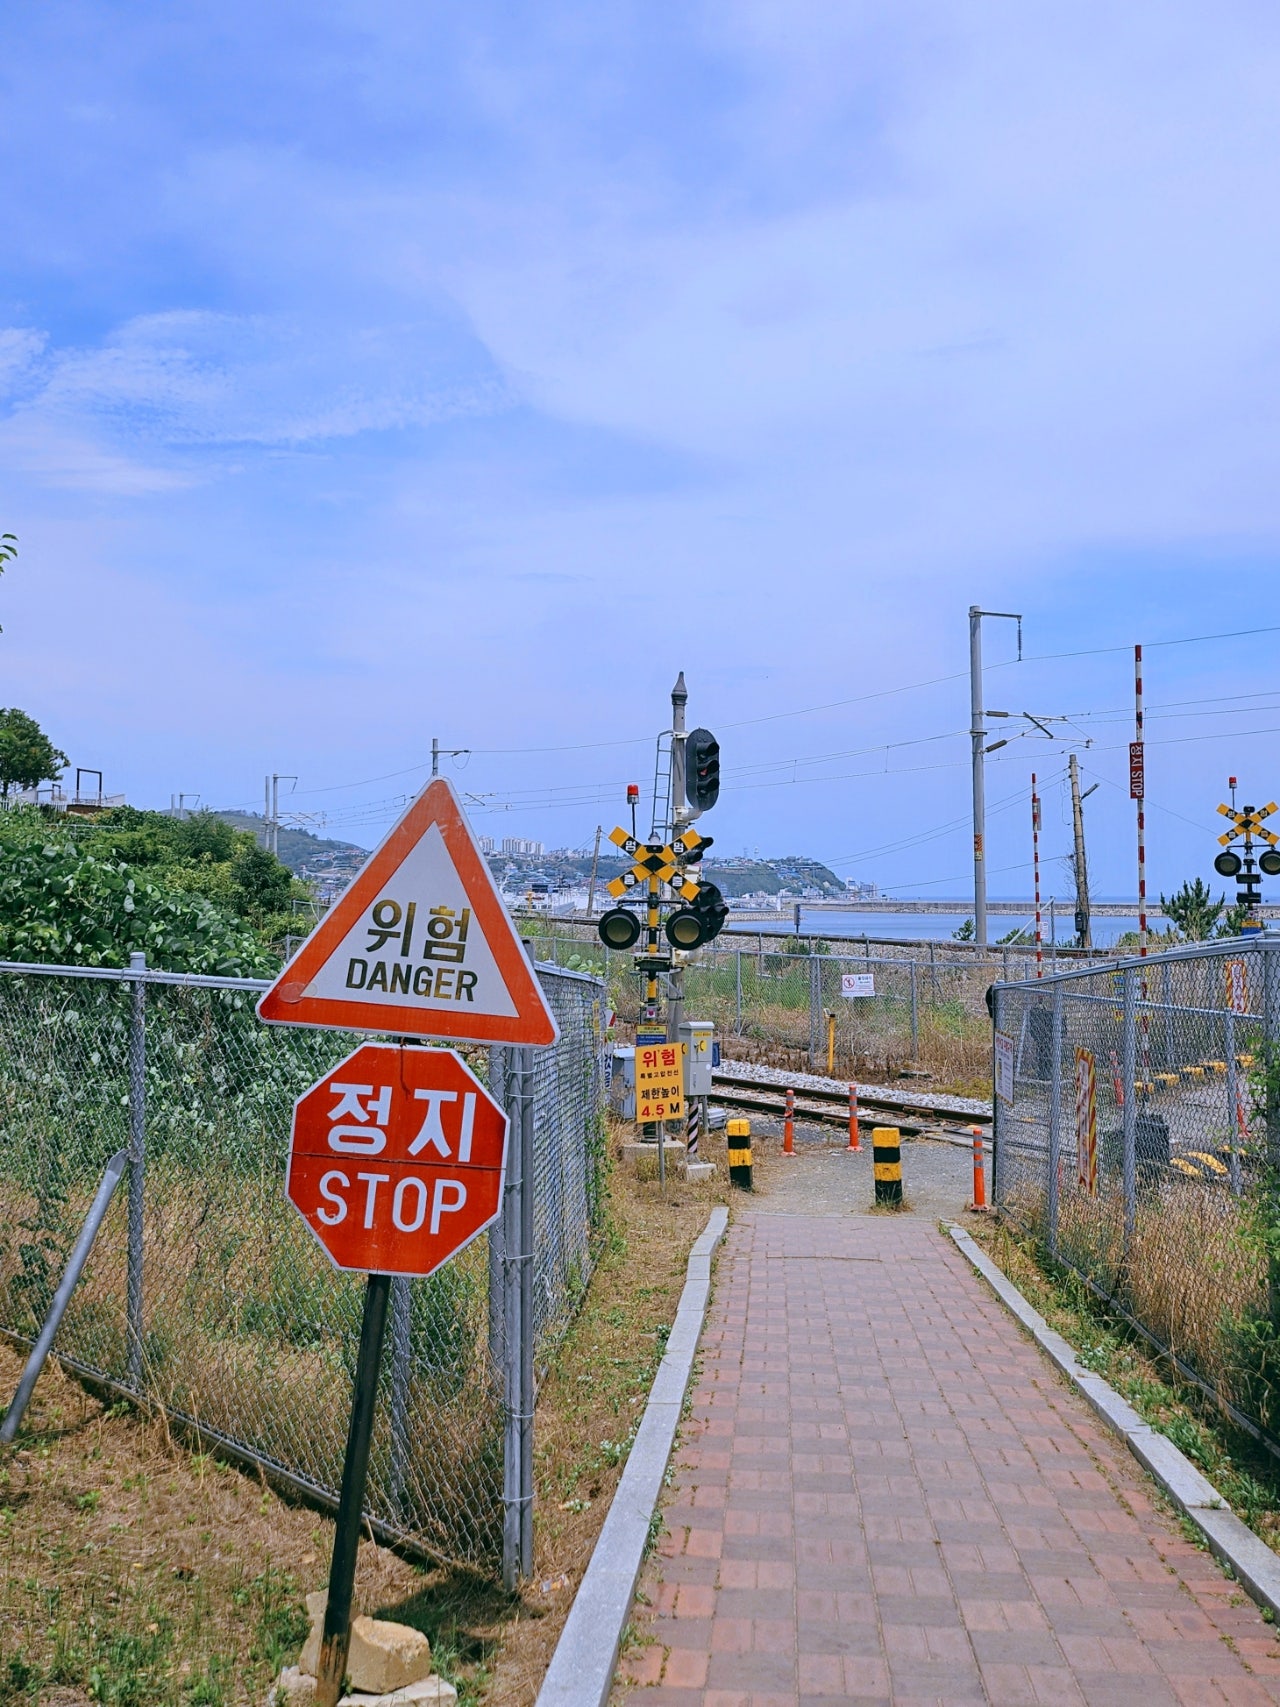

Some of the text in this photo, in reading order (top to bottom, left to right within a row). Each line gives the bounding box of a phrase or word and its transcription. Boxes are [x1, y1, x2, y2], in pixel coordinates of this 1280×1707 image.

[1131, 744, 1143, 796] 정지 STOP
[365, 898, 471, 963] 위험
[345, 957, 479, 1002] DANGER
[642, 1048, 676, 1068] 위험
[326, 1082, 478, 1163] 정지
[641, 1102, 680, 1118] 4.5 M
[317, 1170, 468, 1235] STOP
